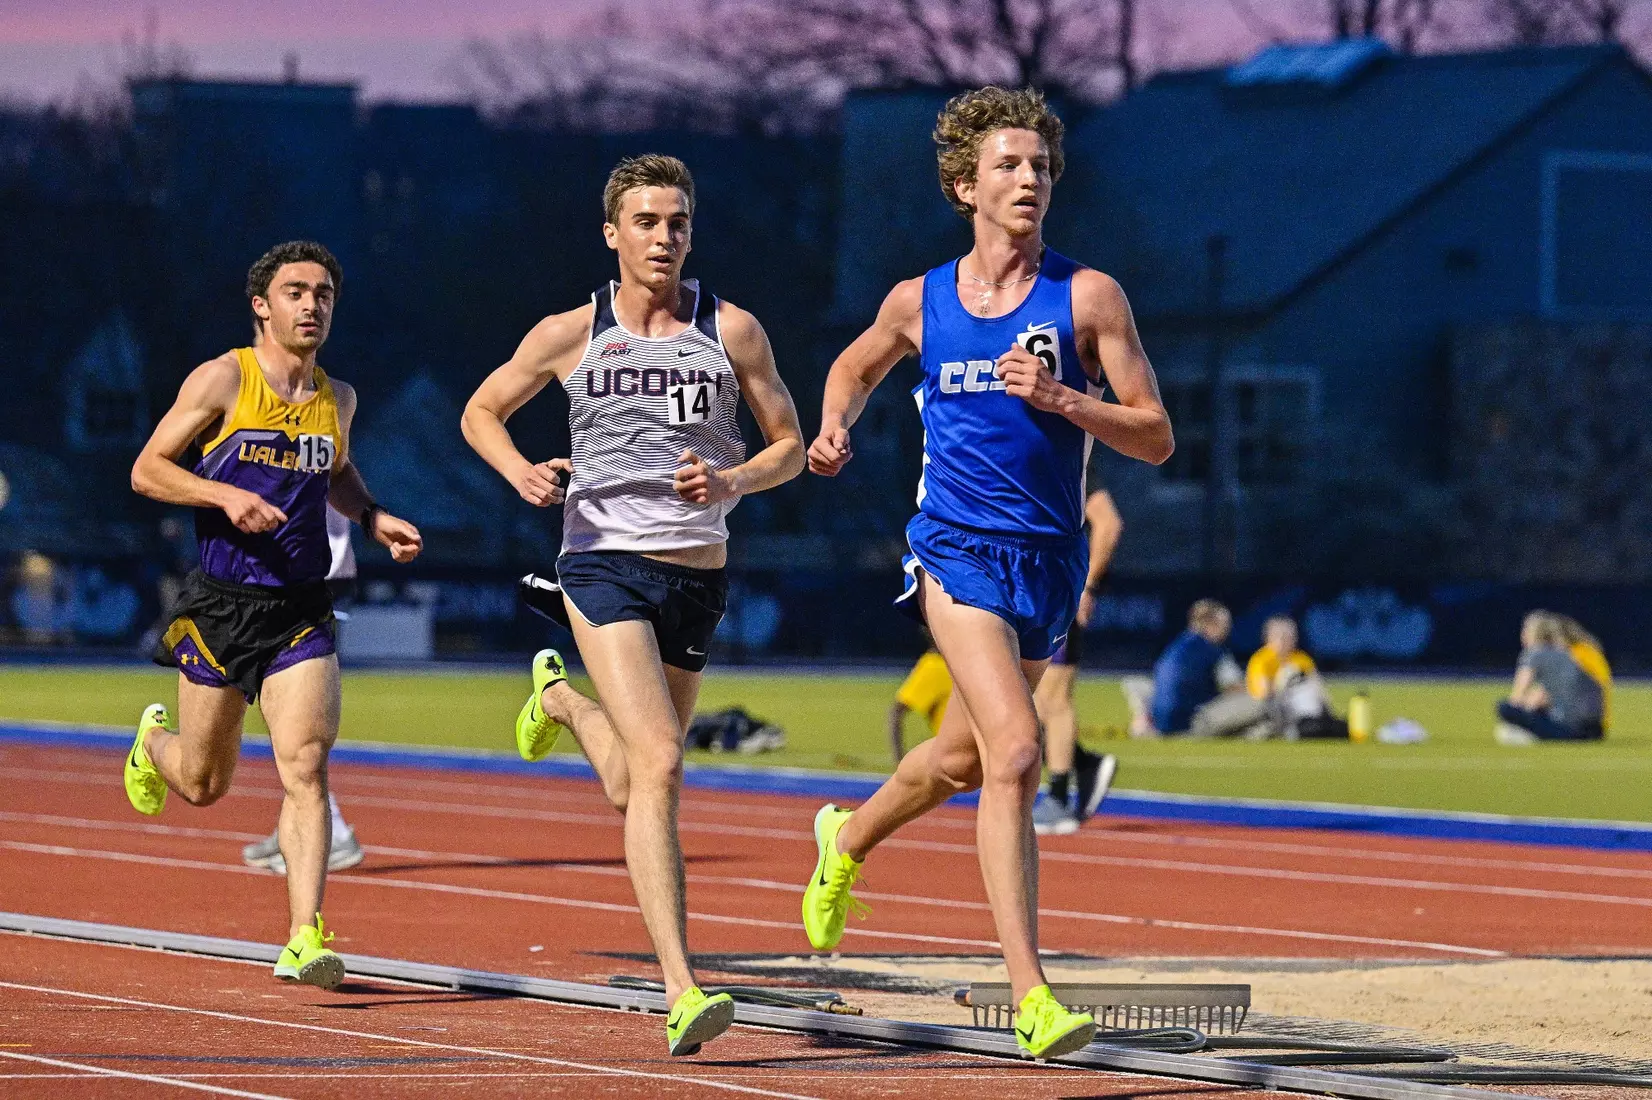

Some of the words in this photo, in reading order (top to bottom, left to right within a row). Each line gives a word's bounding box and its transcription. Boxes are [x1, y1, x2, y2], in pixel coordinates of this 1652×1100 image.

[1026, 334, 1057, 377] 6
[587, 367, 722, 398] UCONN
[671, 385, 711, 422] 14
[239, 442, 322, 474] UALB
[303, 437, 329, 468] 15
